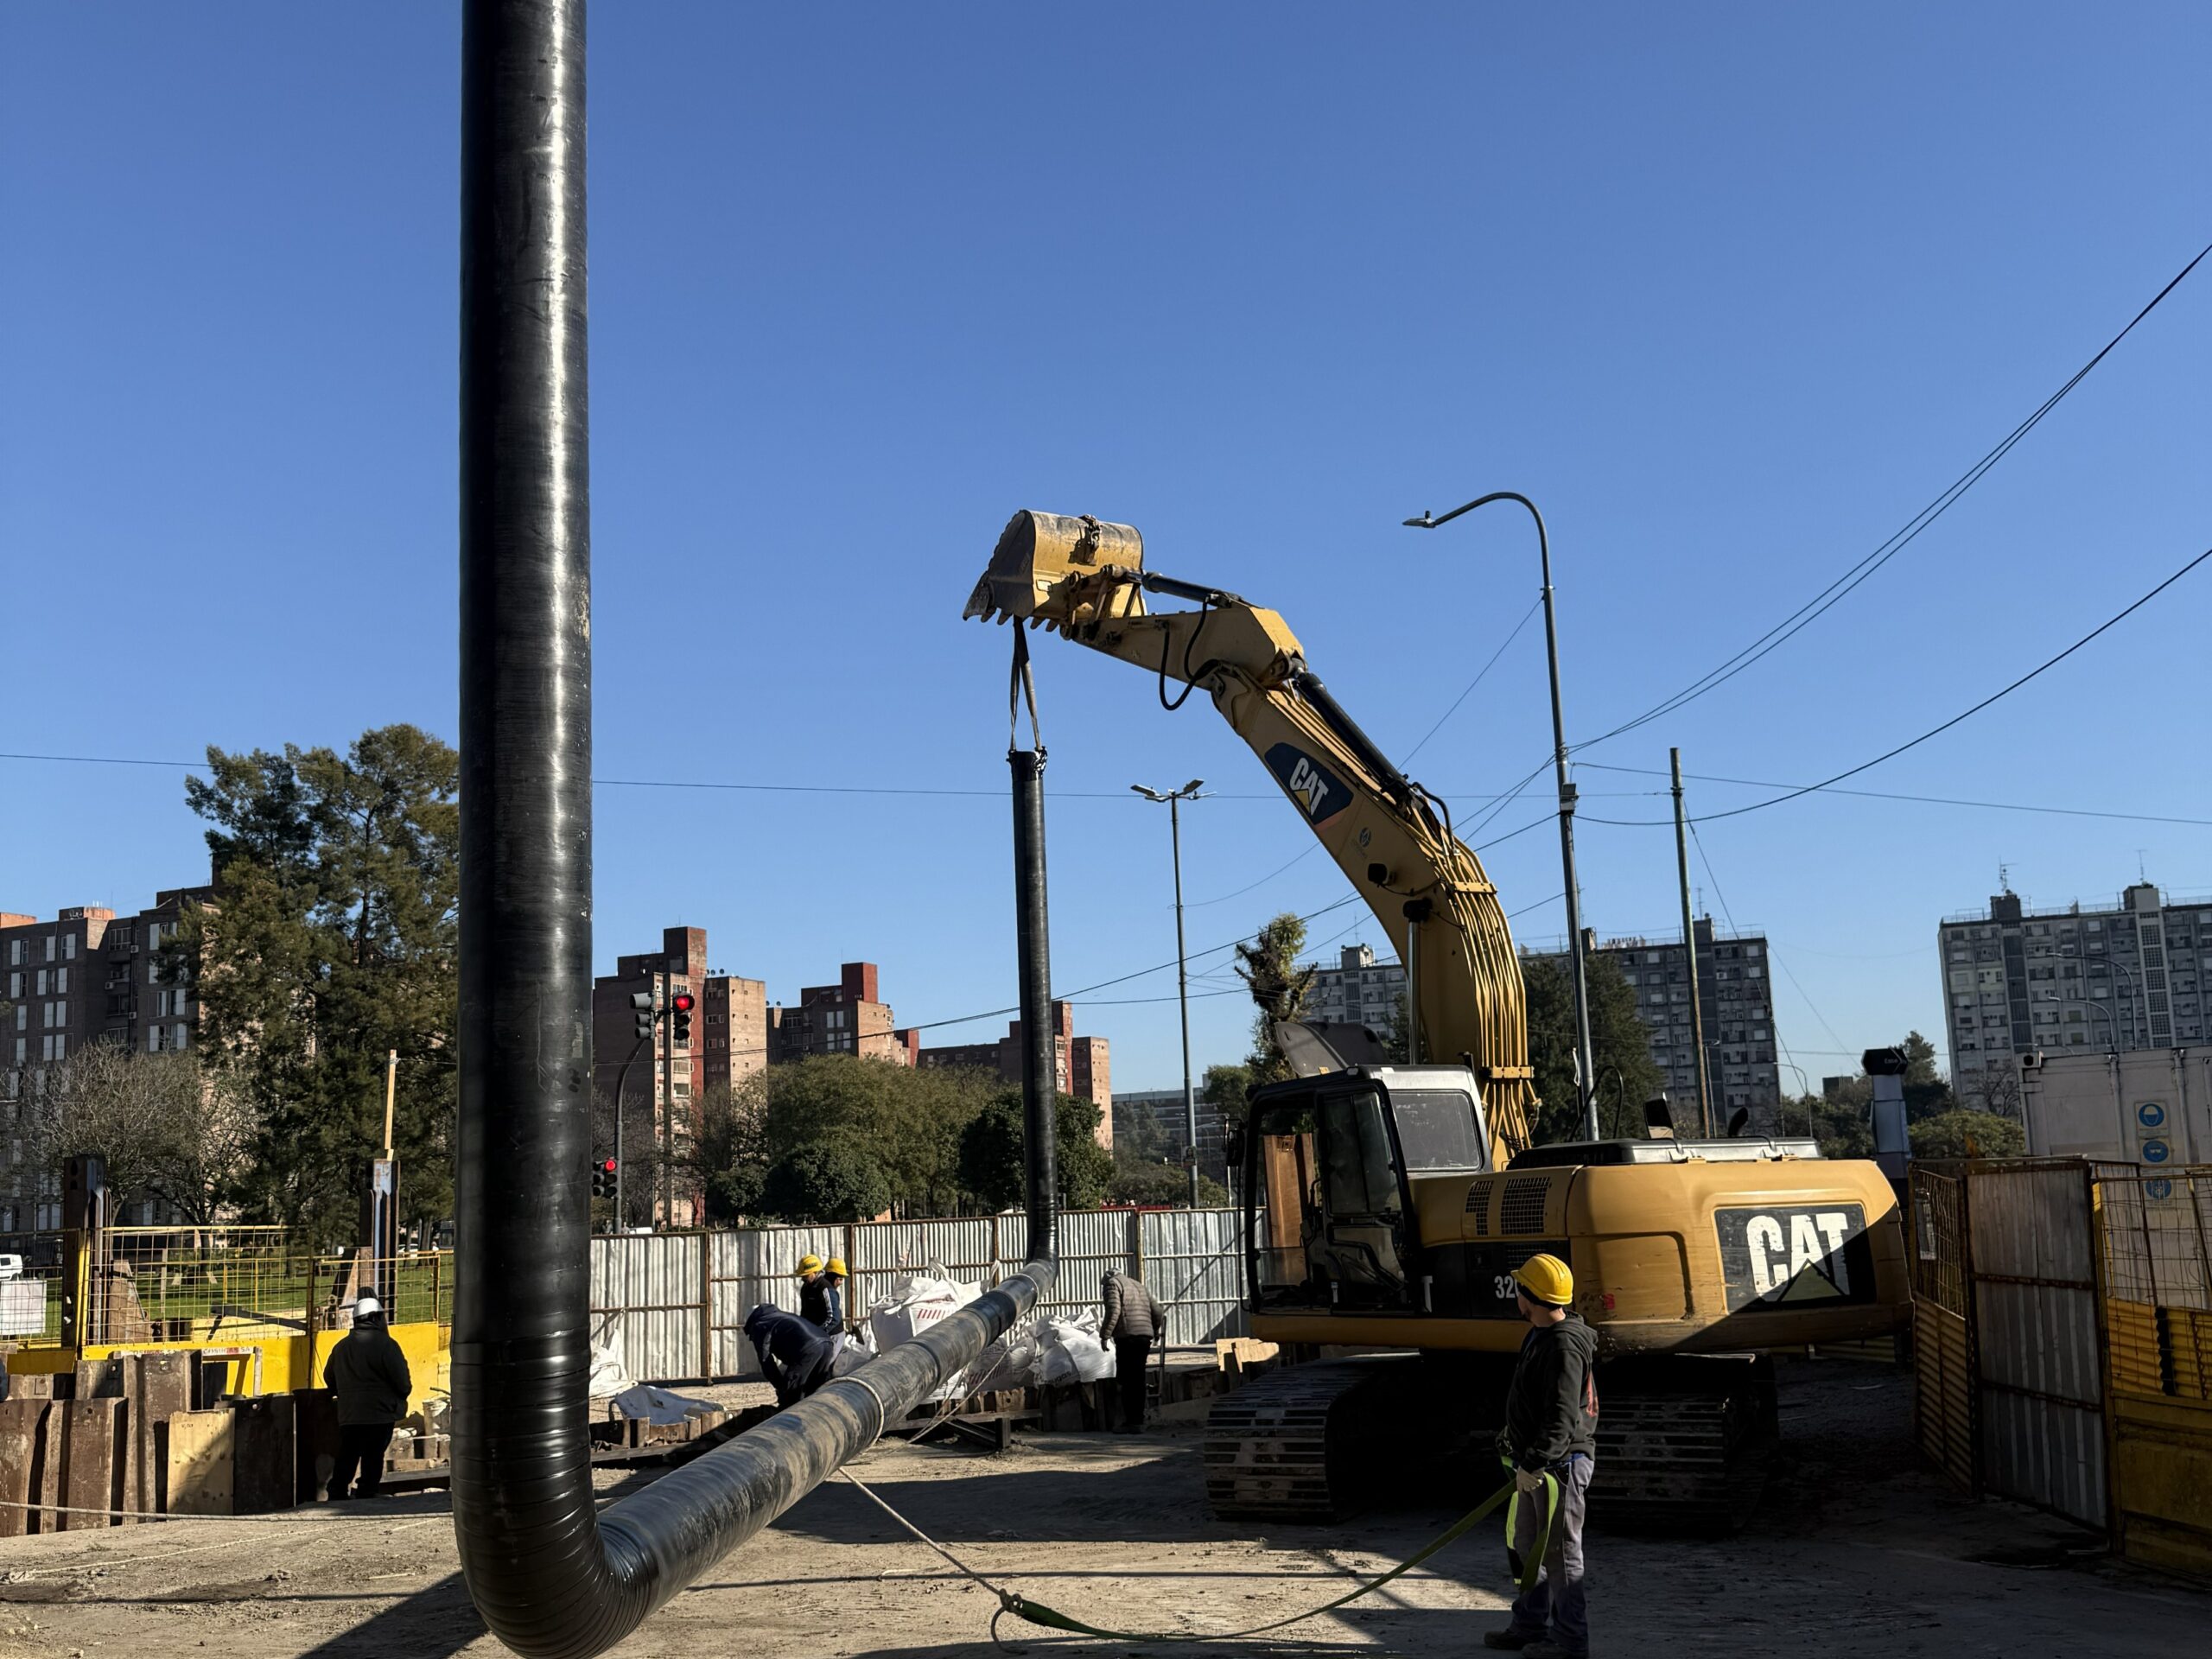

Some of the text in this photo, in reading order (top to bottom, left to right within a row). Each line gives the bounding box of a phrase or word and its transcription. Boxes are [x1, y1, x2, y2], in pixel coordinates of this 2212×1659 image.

[1290, 758, 1329, 816] CAT
[1746, 1212, 1851, 1302] CAT
[1494, 1275, 1519, 1299] 32
